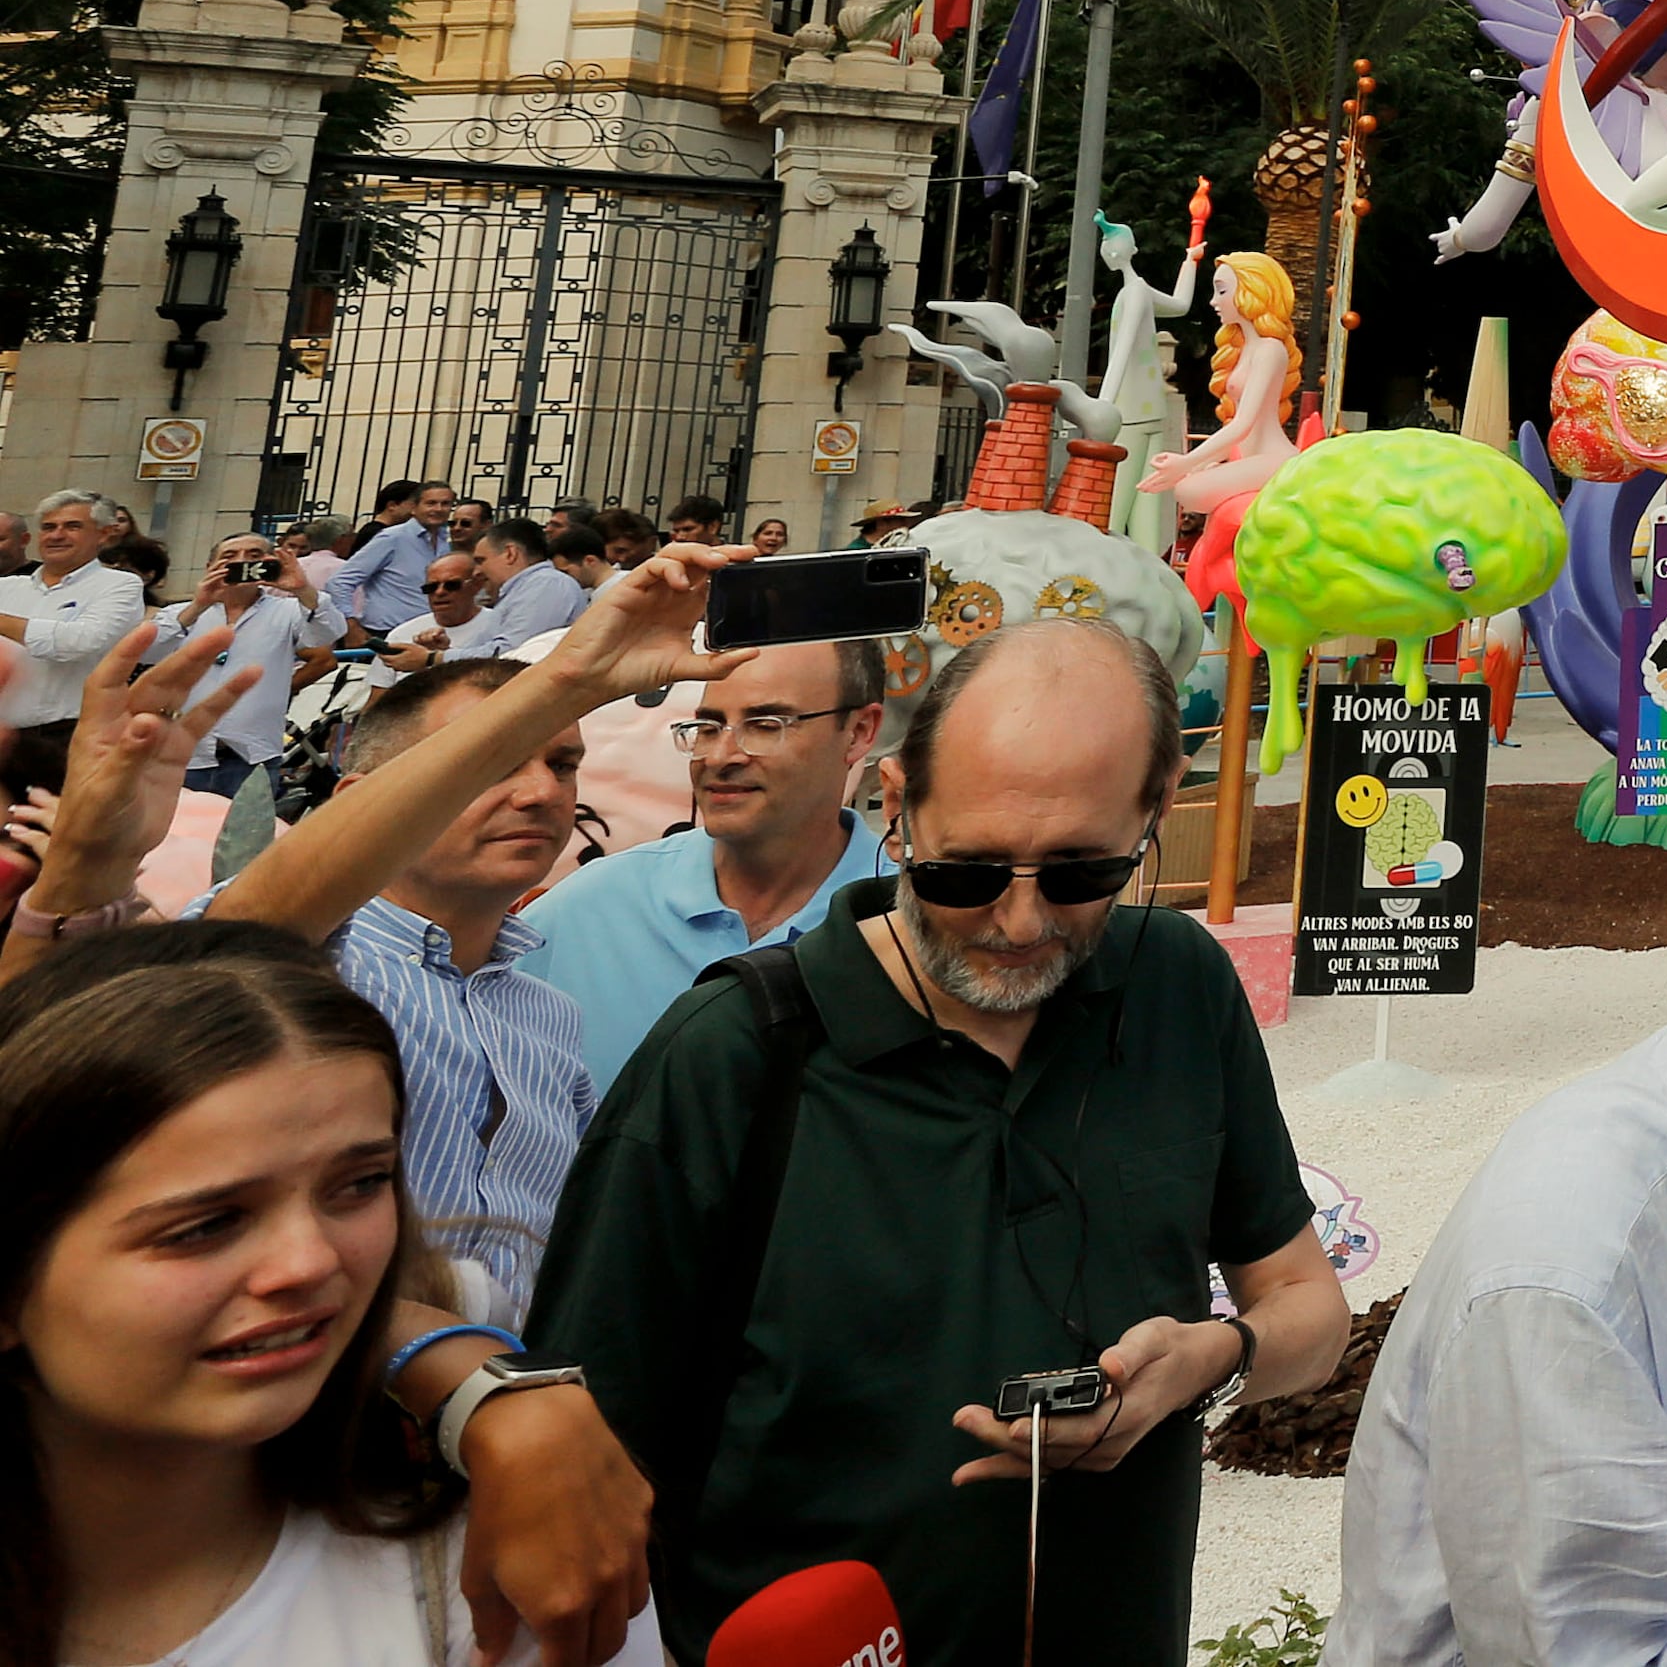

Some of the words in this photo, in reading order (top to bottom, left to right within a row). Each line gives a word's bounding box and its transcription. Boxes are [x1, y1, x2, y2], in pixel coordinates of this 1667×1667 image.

[1331, 693, 1412, 723] HOMO
[1420, 696, 1452, 723] DE
[1458, 696, 1482, 723] LA
[1360, 728, 1458, 755] MOVIDA
[1635, 737, 1652, 752] LA
[1629, 756, 1667, 771] ANAVA
[1618, 774, 1628, 789] A
[1631, 775, 1649, 788] UN
[1300, 915, 1348, 932] ALTRES
[1351, 916, 1394, 931] MODES
[1397, 916, 1426, 931] AMB
[1429, 915, 1451, 930] ELS
[1453, 914, 1474, 930] 80
[1312, 937, 1338, 952] VAN
[1341, 936, 1400, 952] ARRIBAR.
[1402, 935, 1460, 955] DROGUES
[1327, 957, 1353, 975] QUE
[1356, 957, 1373, 972] AL
[1376, 956, 1400, 971] SER
[1336, 977, 1362, 993] VAN
[841, 1626, 902, 1667] ne
